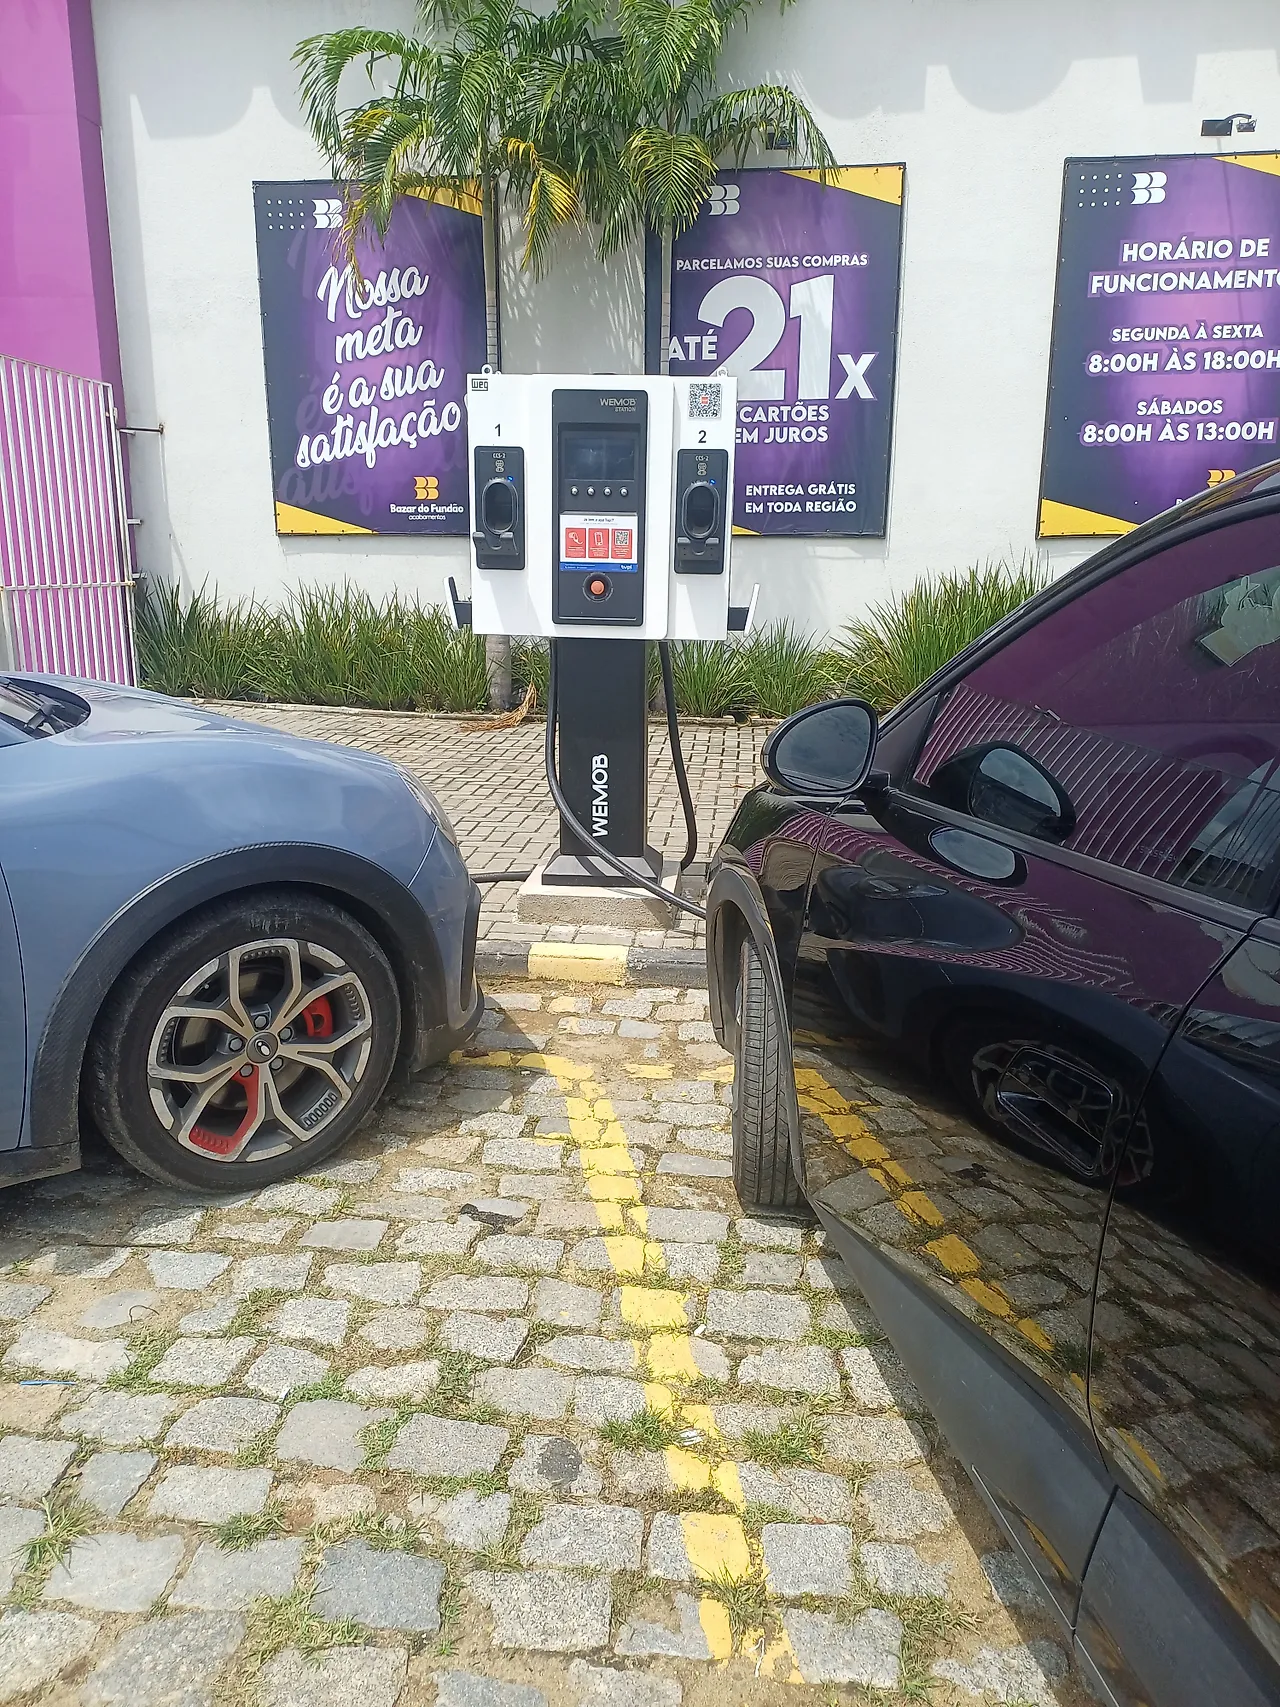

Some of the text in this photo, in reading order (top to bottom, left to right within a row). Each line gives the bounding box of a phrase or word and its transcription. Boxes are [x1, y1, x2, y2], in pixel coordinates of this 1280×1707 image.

[1122, 236, 1270, 262] HORÁRIO DE
[676, 254, 868, 270] PARCELAMOS SUAS COMPRAS
[317, 264, 429, 322] Nossa
[335, 306, 424, 364] meta
[1111, 322, 1264, 342] SEGUNDA À SEXTA
[669, 329, 718, 360] ATÉ
[1088, 348, 1280, 373] 8:00H ÀS 18:00H
[322, 360, 445, 415] é a sua
[600, 398, 636, 406] WEMOB
[739, 401, 830, 423] CARTÕES
[1136, 397, 1223, 416] SÁBADOS
[297, 394, 467, 469] satisfação
[494, 423, 501, 437] 1
[698, 429, 707, 443] 2
[735, 426, 829, 443] EM JUROS
[1083, 418, 1275, 443] 8:00H ÀS 13:00H
[745, 481, 856, 496] ENTREGA GRÁTIS
[390, 503, 464, 513] Bazar do Fundão
[745, 498, 857, 513] EM TODA REGIÃO
[591, 754, 609, 837] WEMOB
